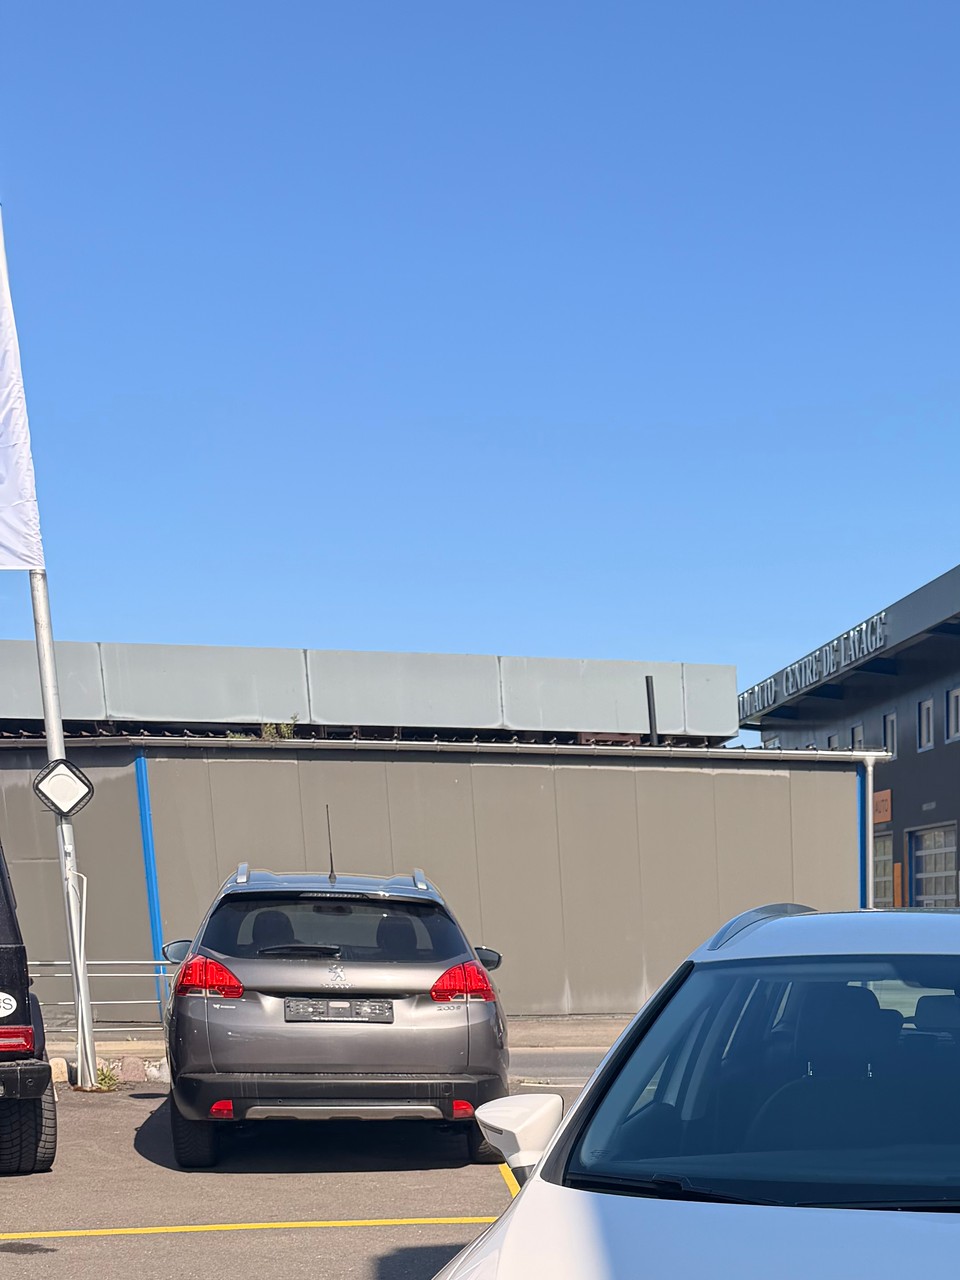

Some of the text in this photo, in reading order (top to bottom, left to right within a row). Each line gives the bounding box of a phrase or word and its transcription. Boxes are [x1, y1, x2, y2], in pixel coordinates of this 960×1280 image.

[754, 677, 775, 712] AUTO
[782, 651, 820, 697] CENTRE
[822, 640, 838, 677] DE
[840, 611, 887, 667] LAVAGE
